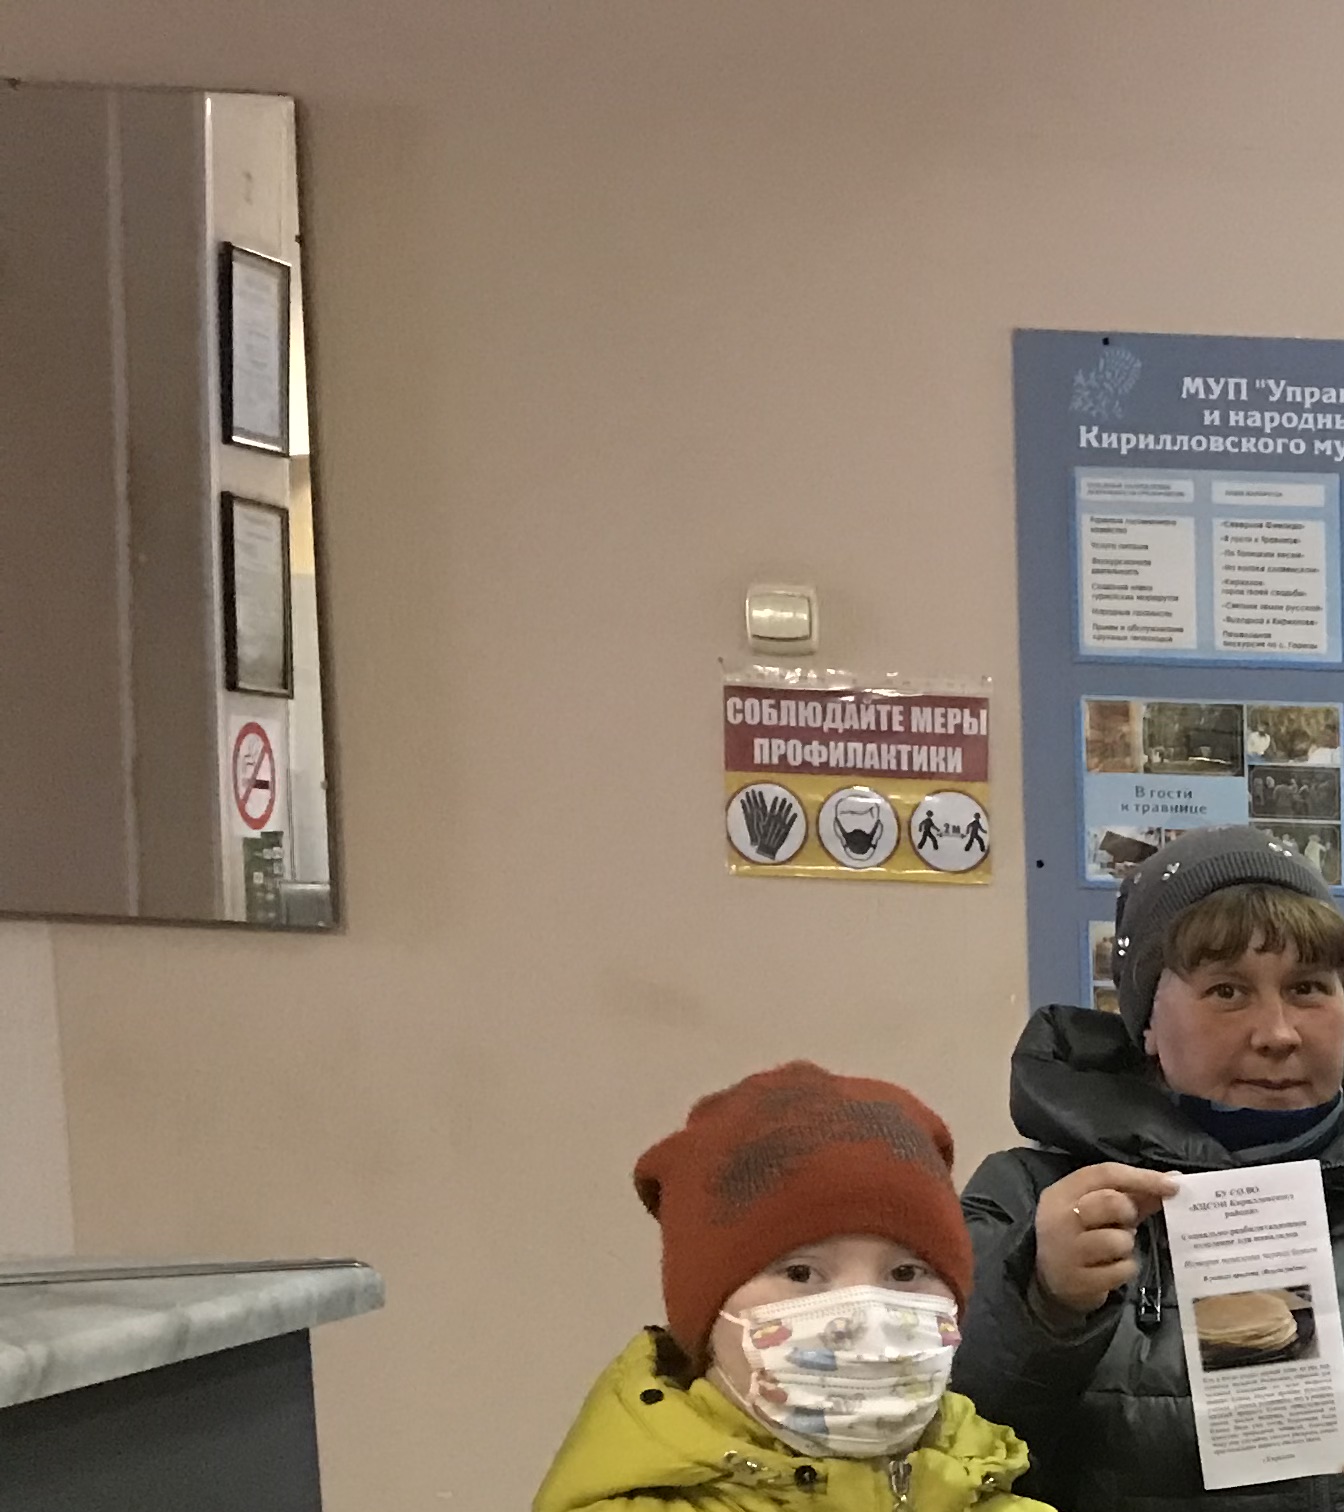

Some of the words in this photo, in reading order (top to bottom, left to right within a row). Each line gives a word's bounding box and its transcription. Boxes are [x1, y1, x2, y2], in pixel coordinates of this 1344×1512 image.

[1181, 377, 1248, 400] МУП
[1203, 408, 1220, 425] и
[1079, 425, 1305, 454] Кирилловского
[726, 696, 904, 733] СОБЛЮДАЙТЕ
[911, 706, 988, 735] МЕРЫ
[753, 738, 962, 773] ПРОФИЛАКТИКИ
[1135, 785, 1144, 798] В
[1150, 787, 1193, 799] гости
[1135, 804, 1207, 816] травнице
